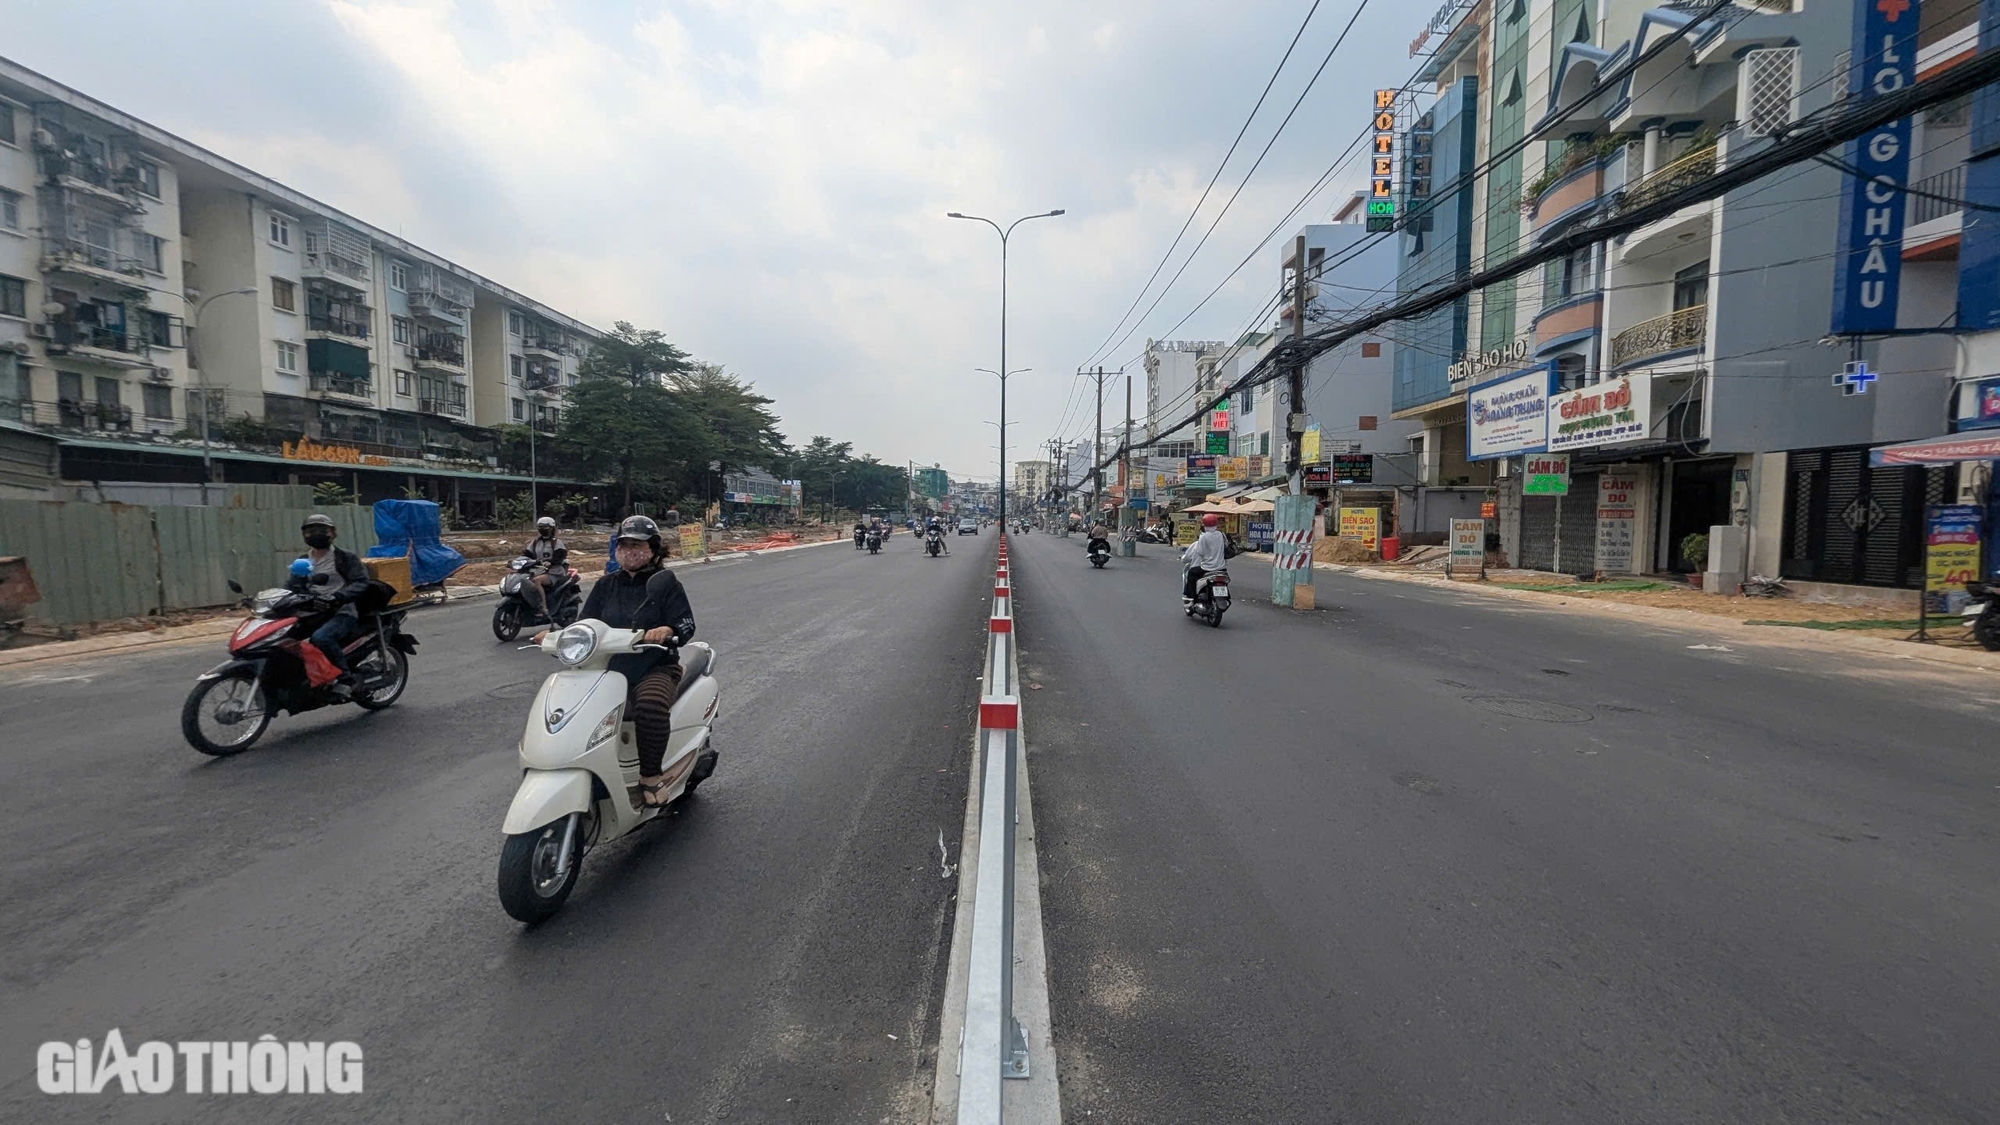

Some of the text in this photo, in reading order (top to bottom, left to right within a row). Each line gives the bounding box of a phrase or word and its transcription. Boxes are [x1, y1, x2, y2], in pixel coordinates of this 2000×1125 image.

[1373, 90, 1395, 198] HOTEL
[1859, 34, 1904, 309] LOG CHÂU
